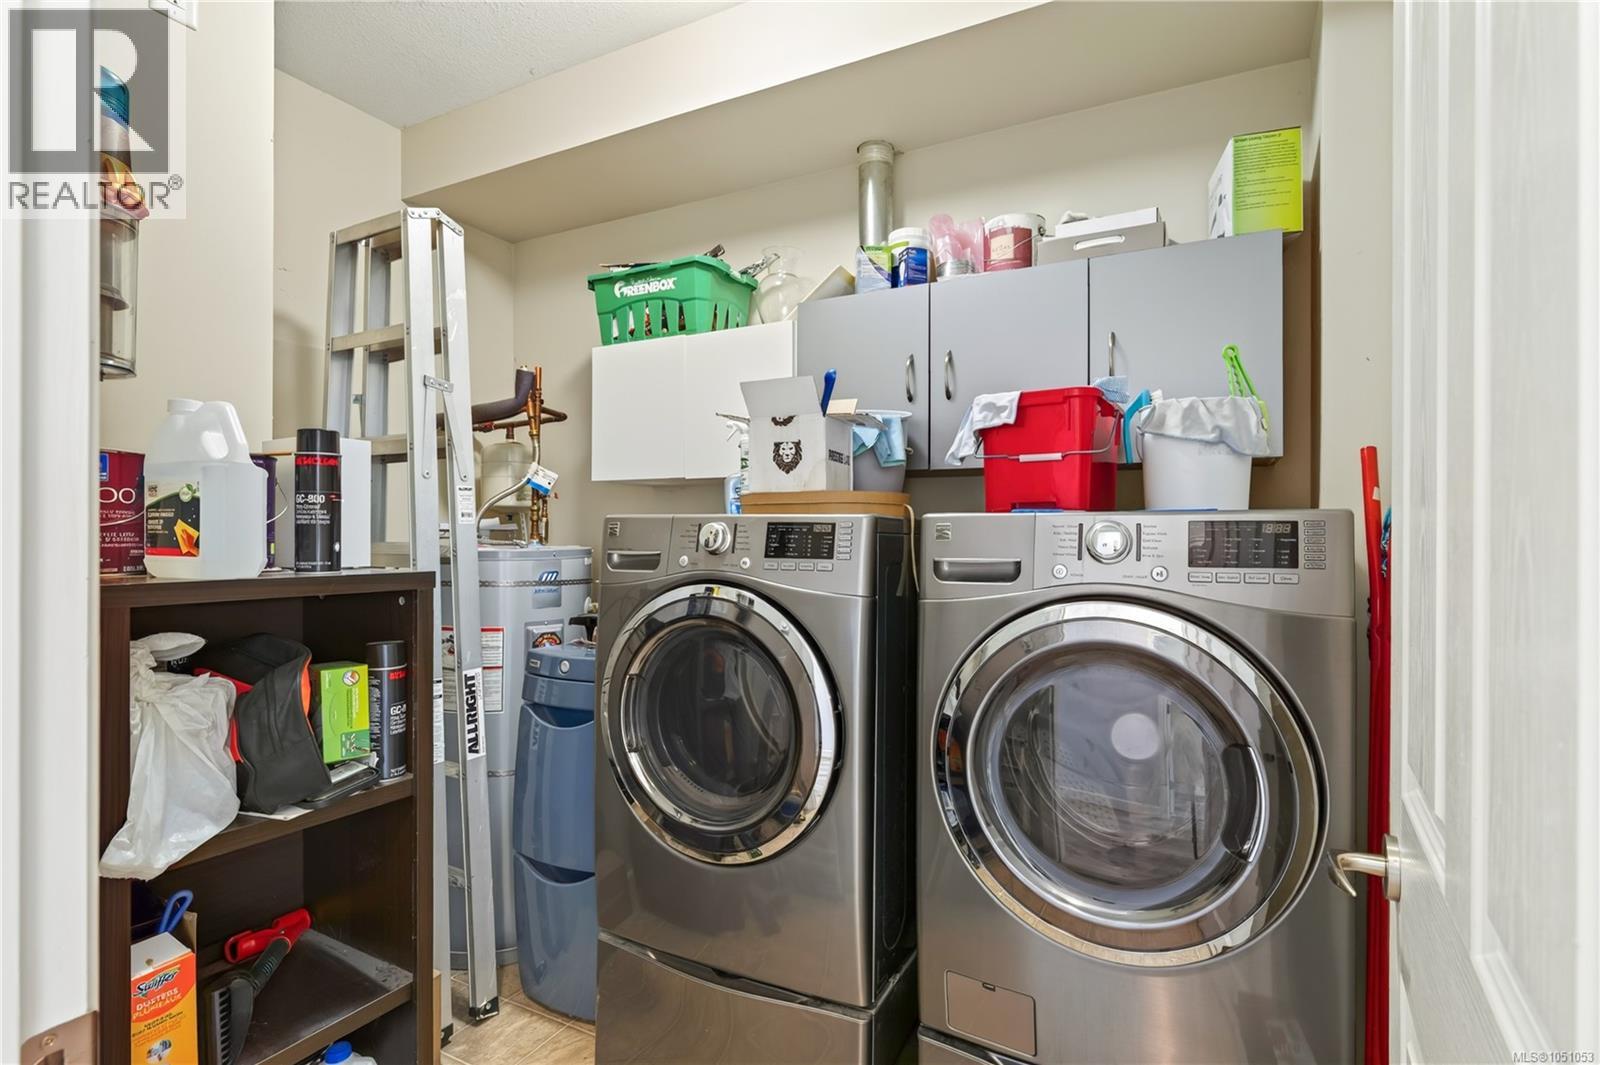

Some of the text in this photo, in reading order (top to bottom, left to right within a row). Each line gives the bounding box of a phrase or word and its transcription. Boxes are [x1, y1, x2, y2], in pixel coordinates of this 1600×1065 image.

[464, 674, 480, 754] ALLRIGHT
[136, 970, 179, 994] Swiffer
[136, 988, 179, 1011] DUSTERS
